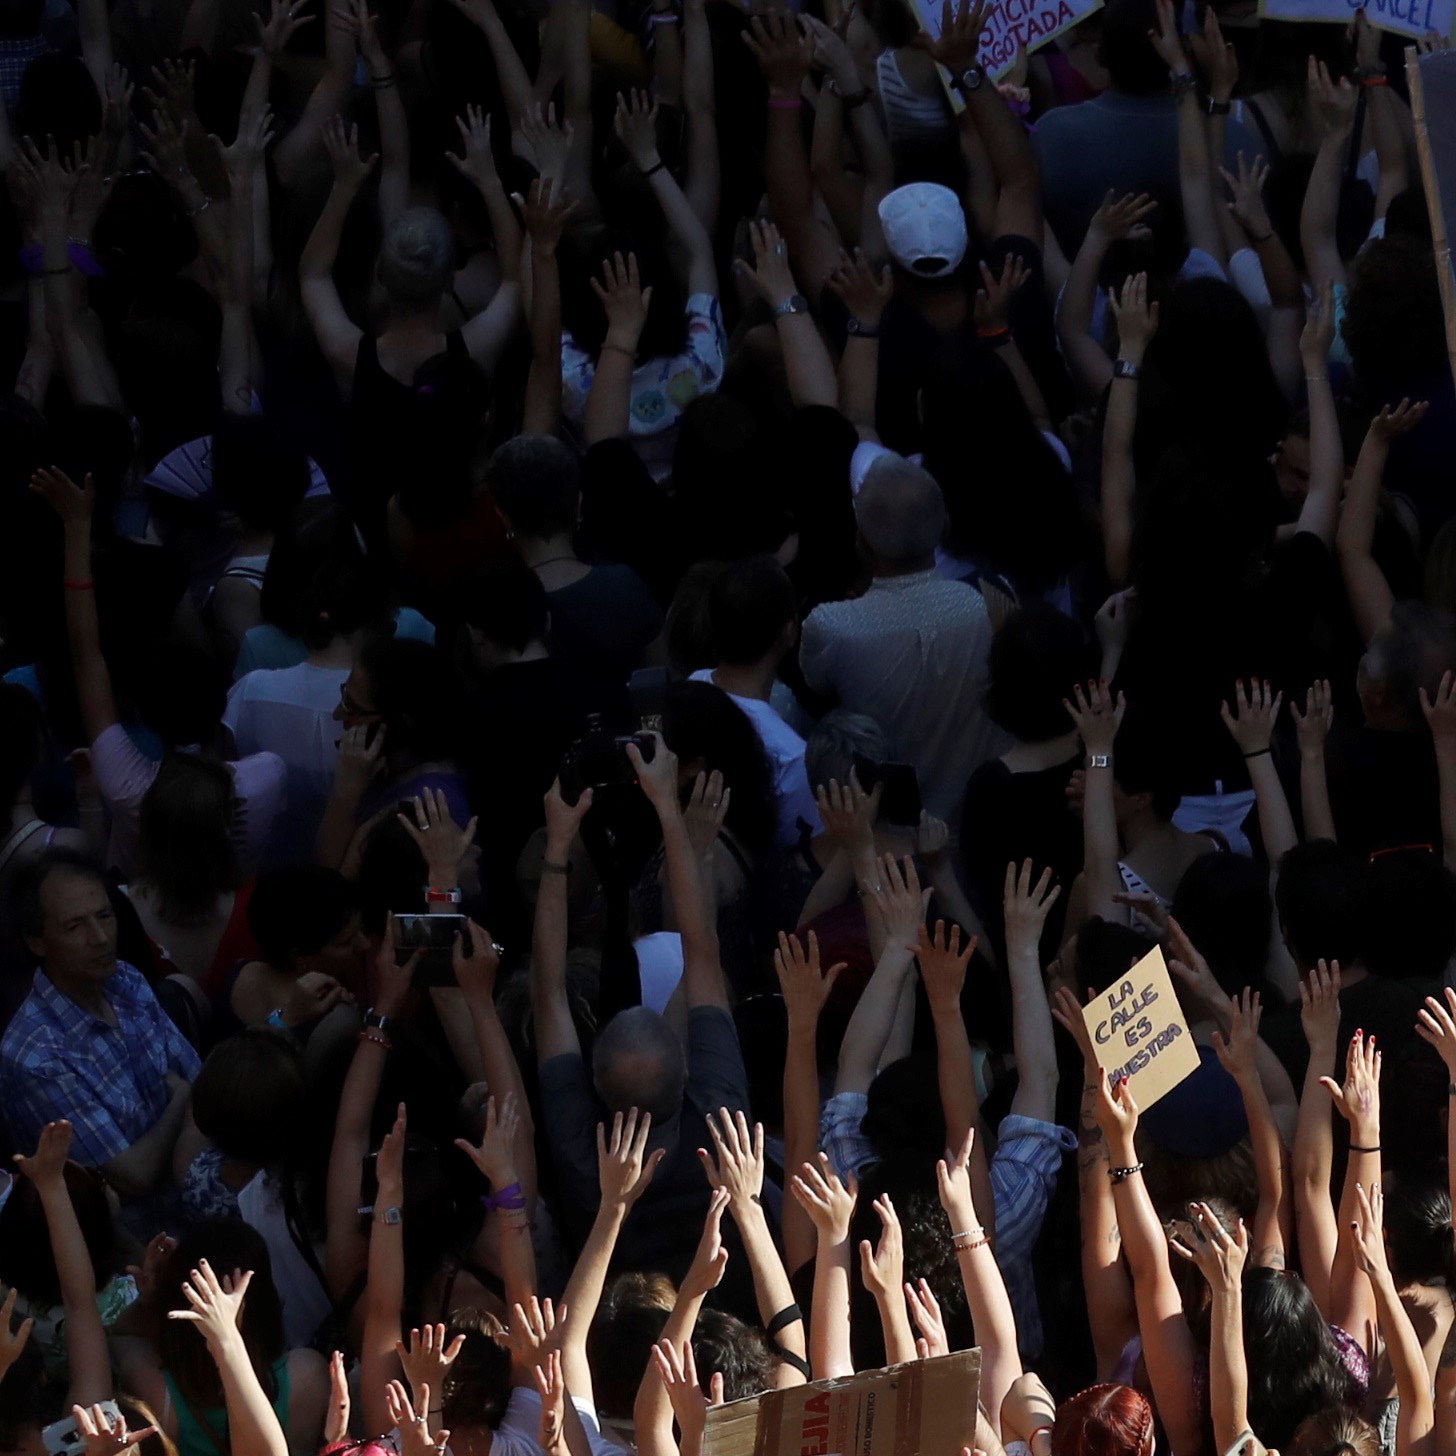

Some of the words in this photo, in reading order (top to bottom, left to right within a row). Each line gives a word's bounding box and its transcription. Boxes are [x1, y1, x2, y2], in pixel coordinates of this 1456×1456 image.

[981, 1, 1075, 73] AGOTADA
[1095, 982, 1159, 1045] CALLE
[1107, 980, 1135, 1010] LA
[1107, 1022, 1183, 1088] NUESTRA
[1124, 1016, 1153, 1047] ES
